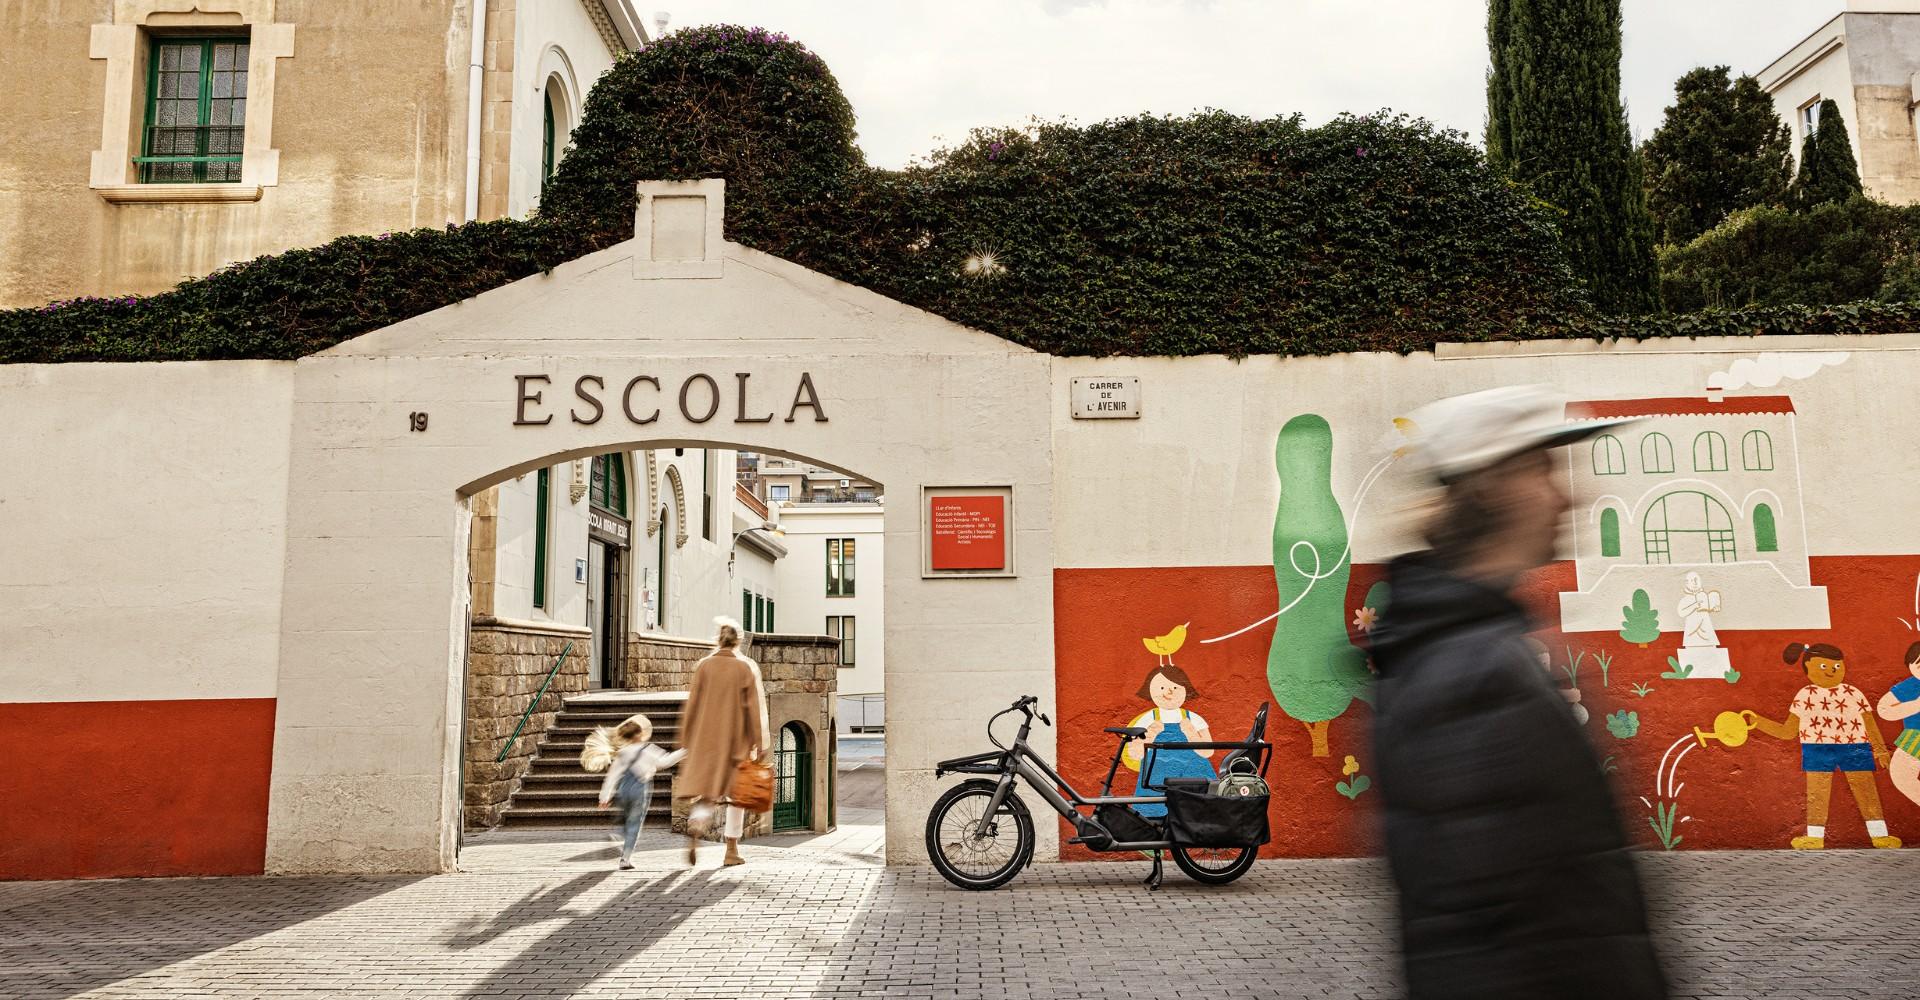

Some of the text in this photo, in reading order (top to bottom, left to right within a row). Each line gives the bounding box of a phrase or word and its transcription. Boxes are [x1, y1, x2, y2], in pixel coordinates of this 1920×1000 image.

[1089, 382, 1123, 390] CARRER
[513, 372, 829, 426] ESCOLA
[1097, 401, 1127, 411] AVENIR
[409, 411, 429, 432] 19
[588, 511, 603, 530] SCOLA
